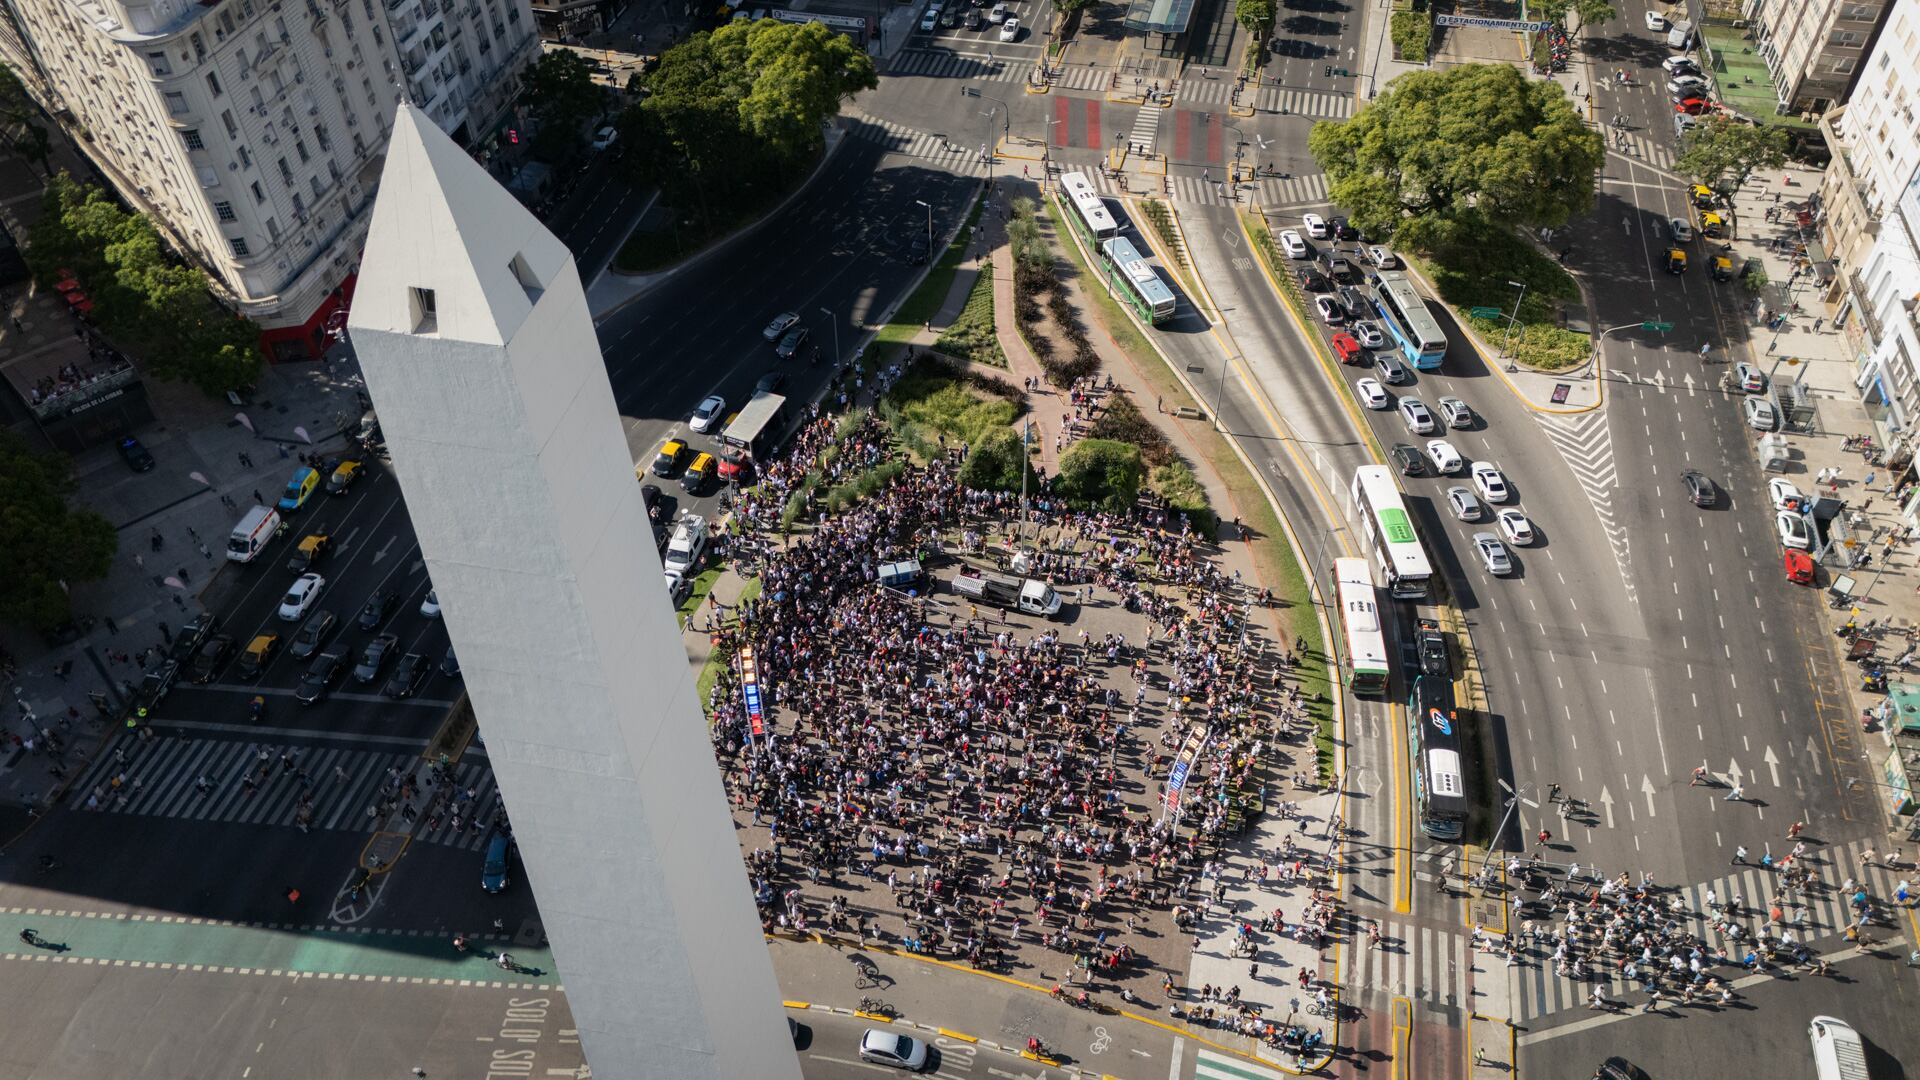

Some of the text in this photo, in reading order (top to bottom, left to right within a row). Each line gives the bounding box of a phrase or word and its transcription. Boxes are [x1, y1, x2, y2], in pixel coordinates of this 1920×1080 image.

[1448, 16, 1529, 29] ESTACIONAMIENTO
[1232, 257, 1253, 271] BUS
[1354, 713, 1380, 738] BS
[500, 998, 550, 1038] SOLO
